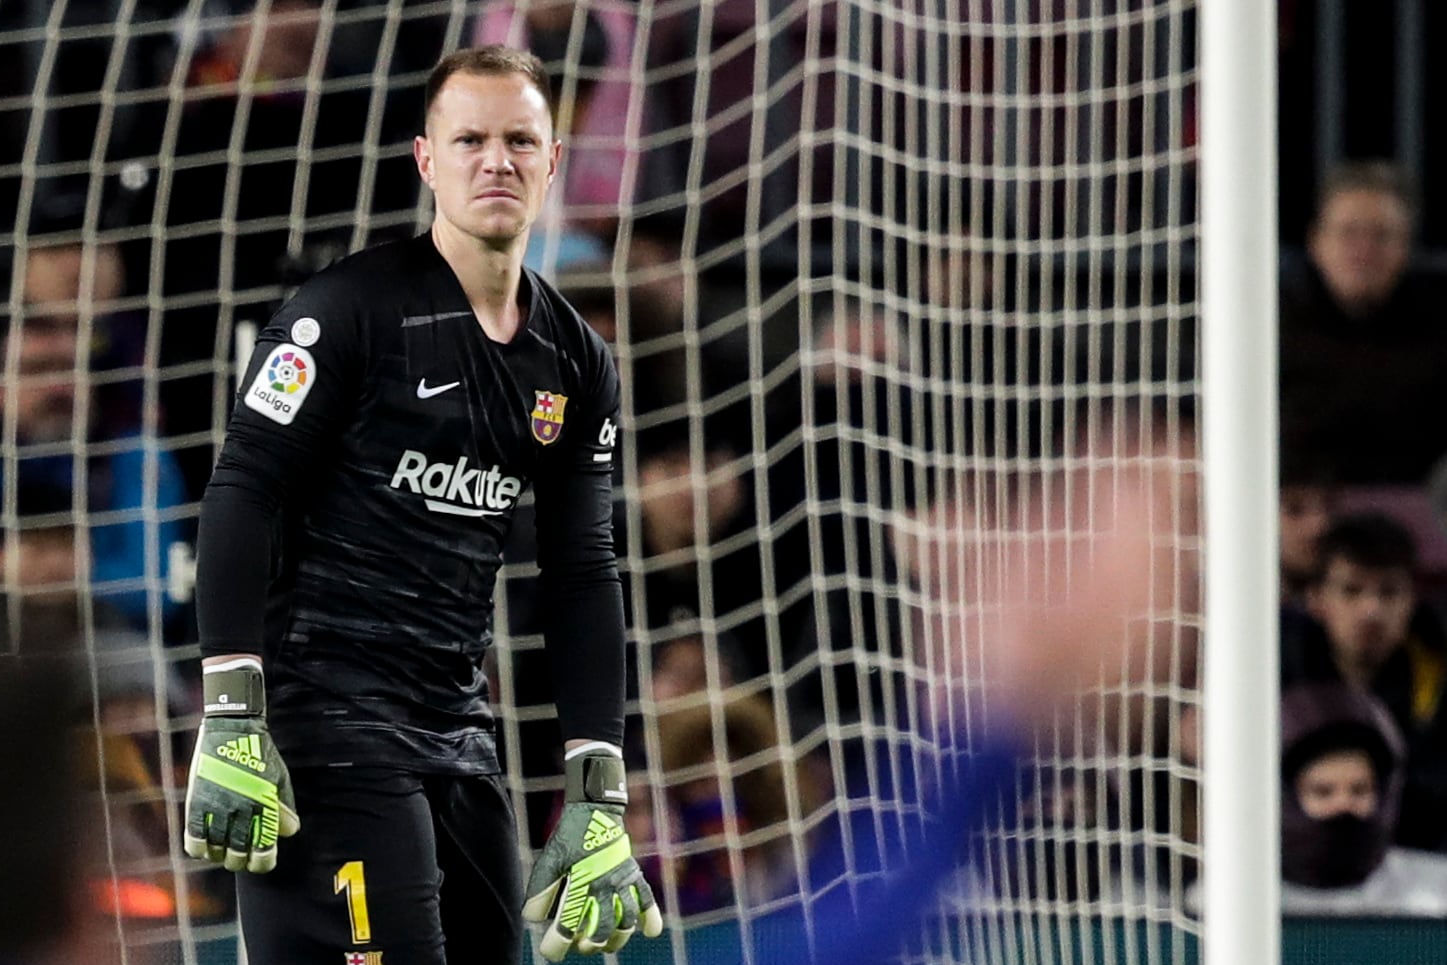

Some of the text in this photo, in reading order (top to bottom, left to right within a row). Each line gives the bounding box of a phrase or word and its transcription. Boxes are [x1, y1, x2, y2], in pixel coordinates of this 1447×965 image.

[254, 387, 292, 413] LaLiga
[390, 449, 521, 509] Rakute
[217, 745, 266, 773] adidas
[583, 823, 623, 851] adidas
[333, 860, 371, 944] 1
